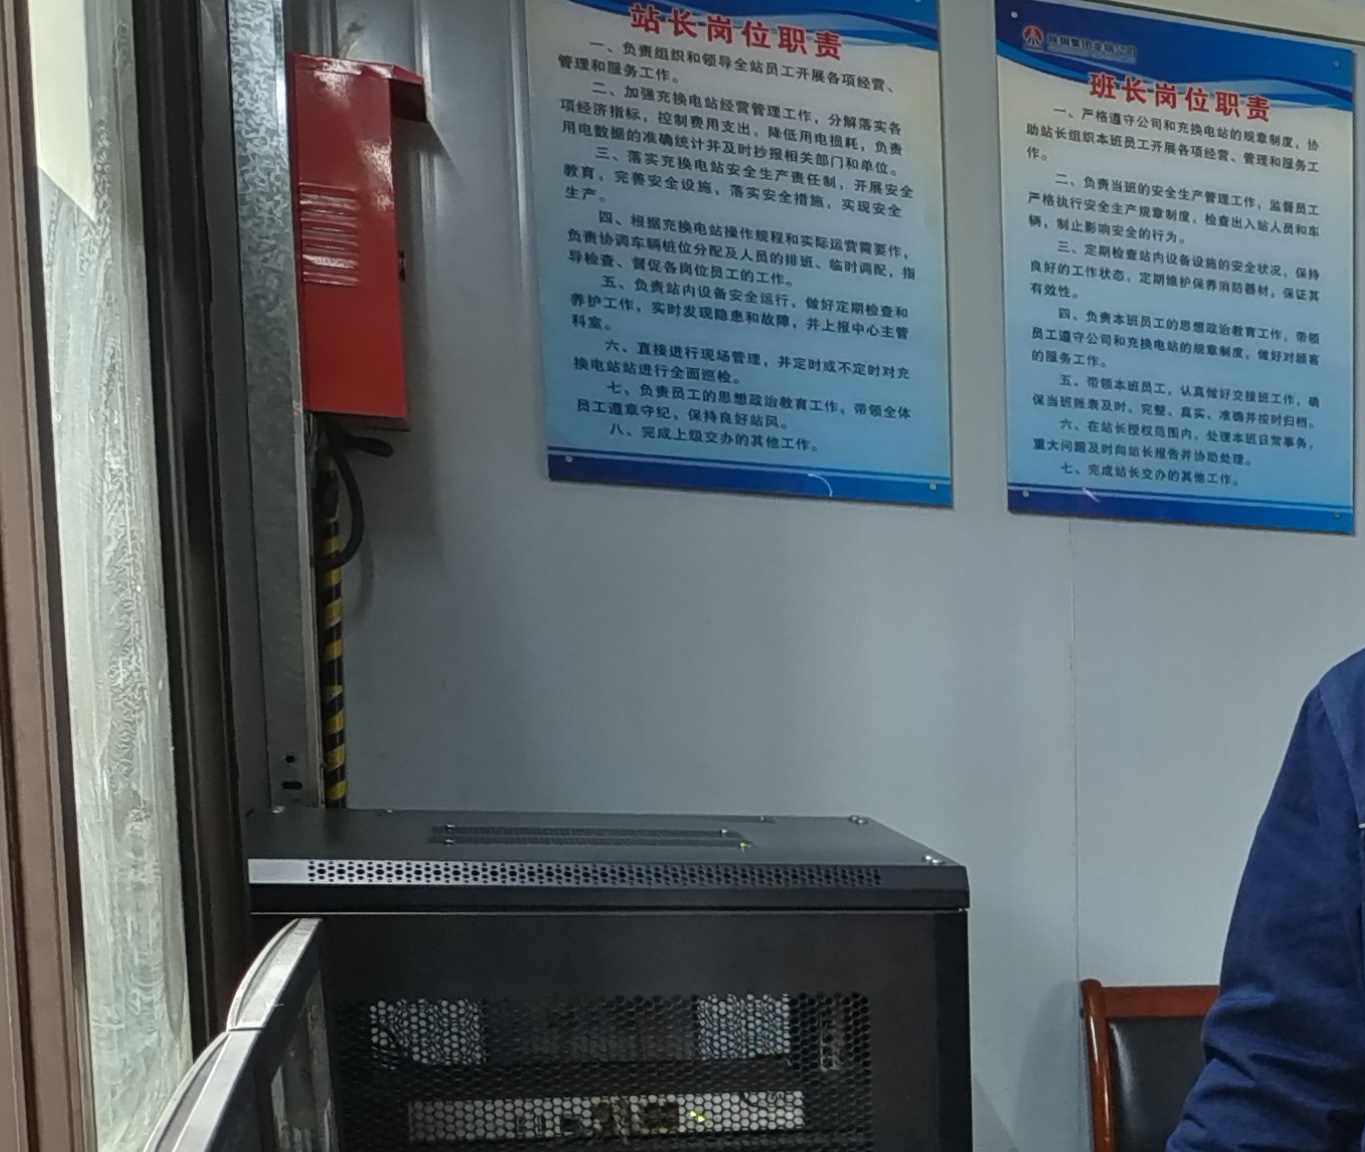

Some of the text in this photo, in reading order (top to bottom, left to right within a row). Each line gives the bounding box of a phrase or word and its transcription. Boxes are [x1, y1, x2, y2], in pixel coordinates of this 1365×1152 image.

[626, 0, 845, 62] 站长岗位职责
[1087, 70, 1272, 124] 班长岗位职责
